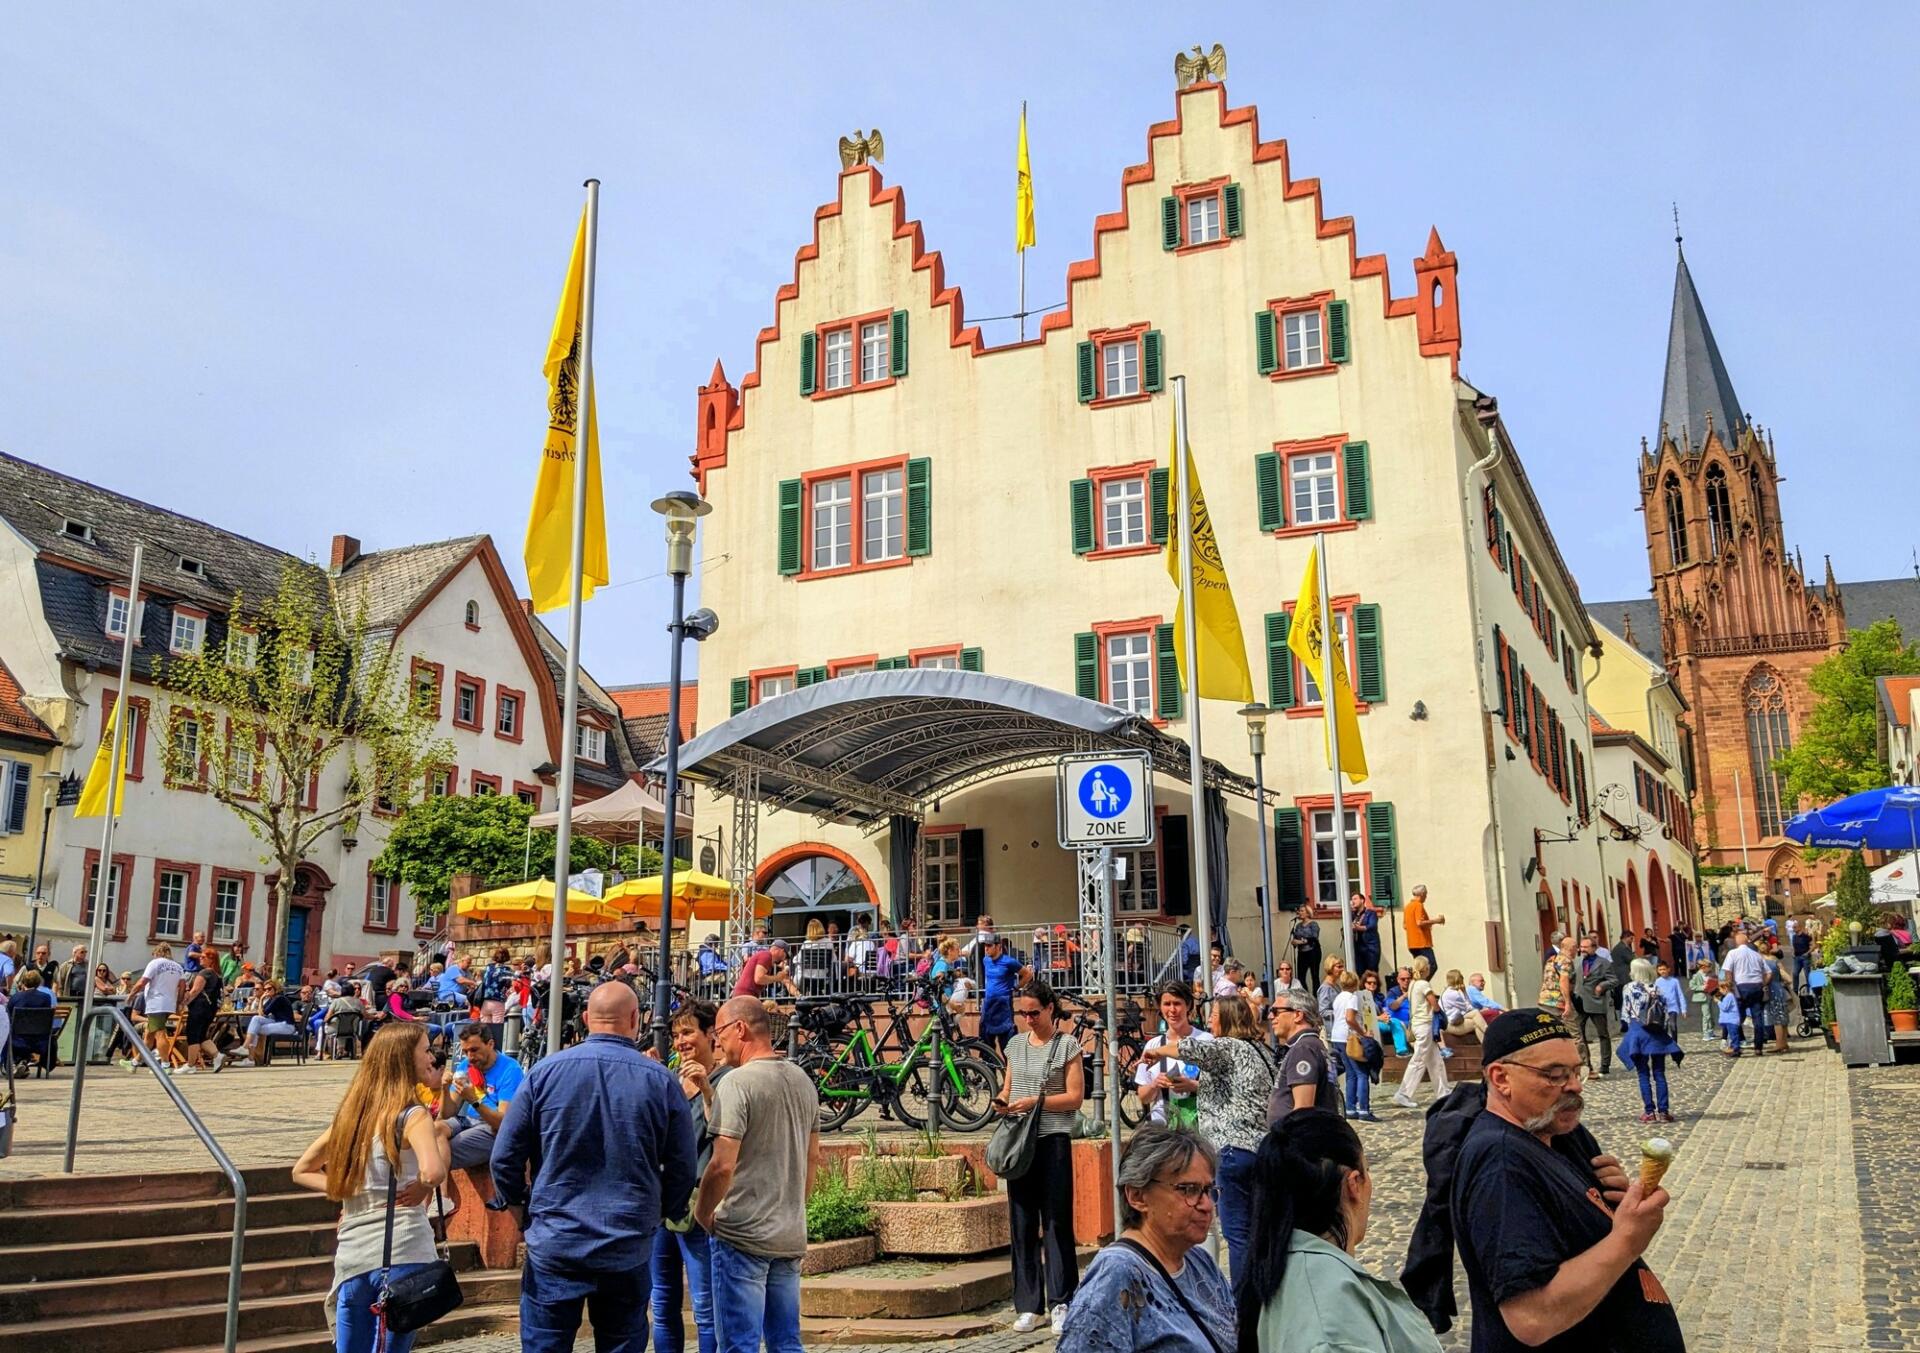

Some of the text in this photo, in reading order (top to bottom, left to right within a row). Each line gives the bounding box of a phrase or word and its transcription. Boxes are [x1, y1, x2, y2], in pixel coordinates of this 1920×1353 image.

[1192, 565, 1229, 591] Oppen
[1086, 821, 1127, 836] ZONE
[1520, 1026, 1555, 1044] WHEELS
